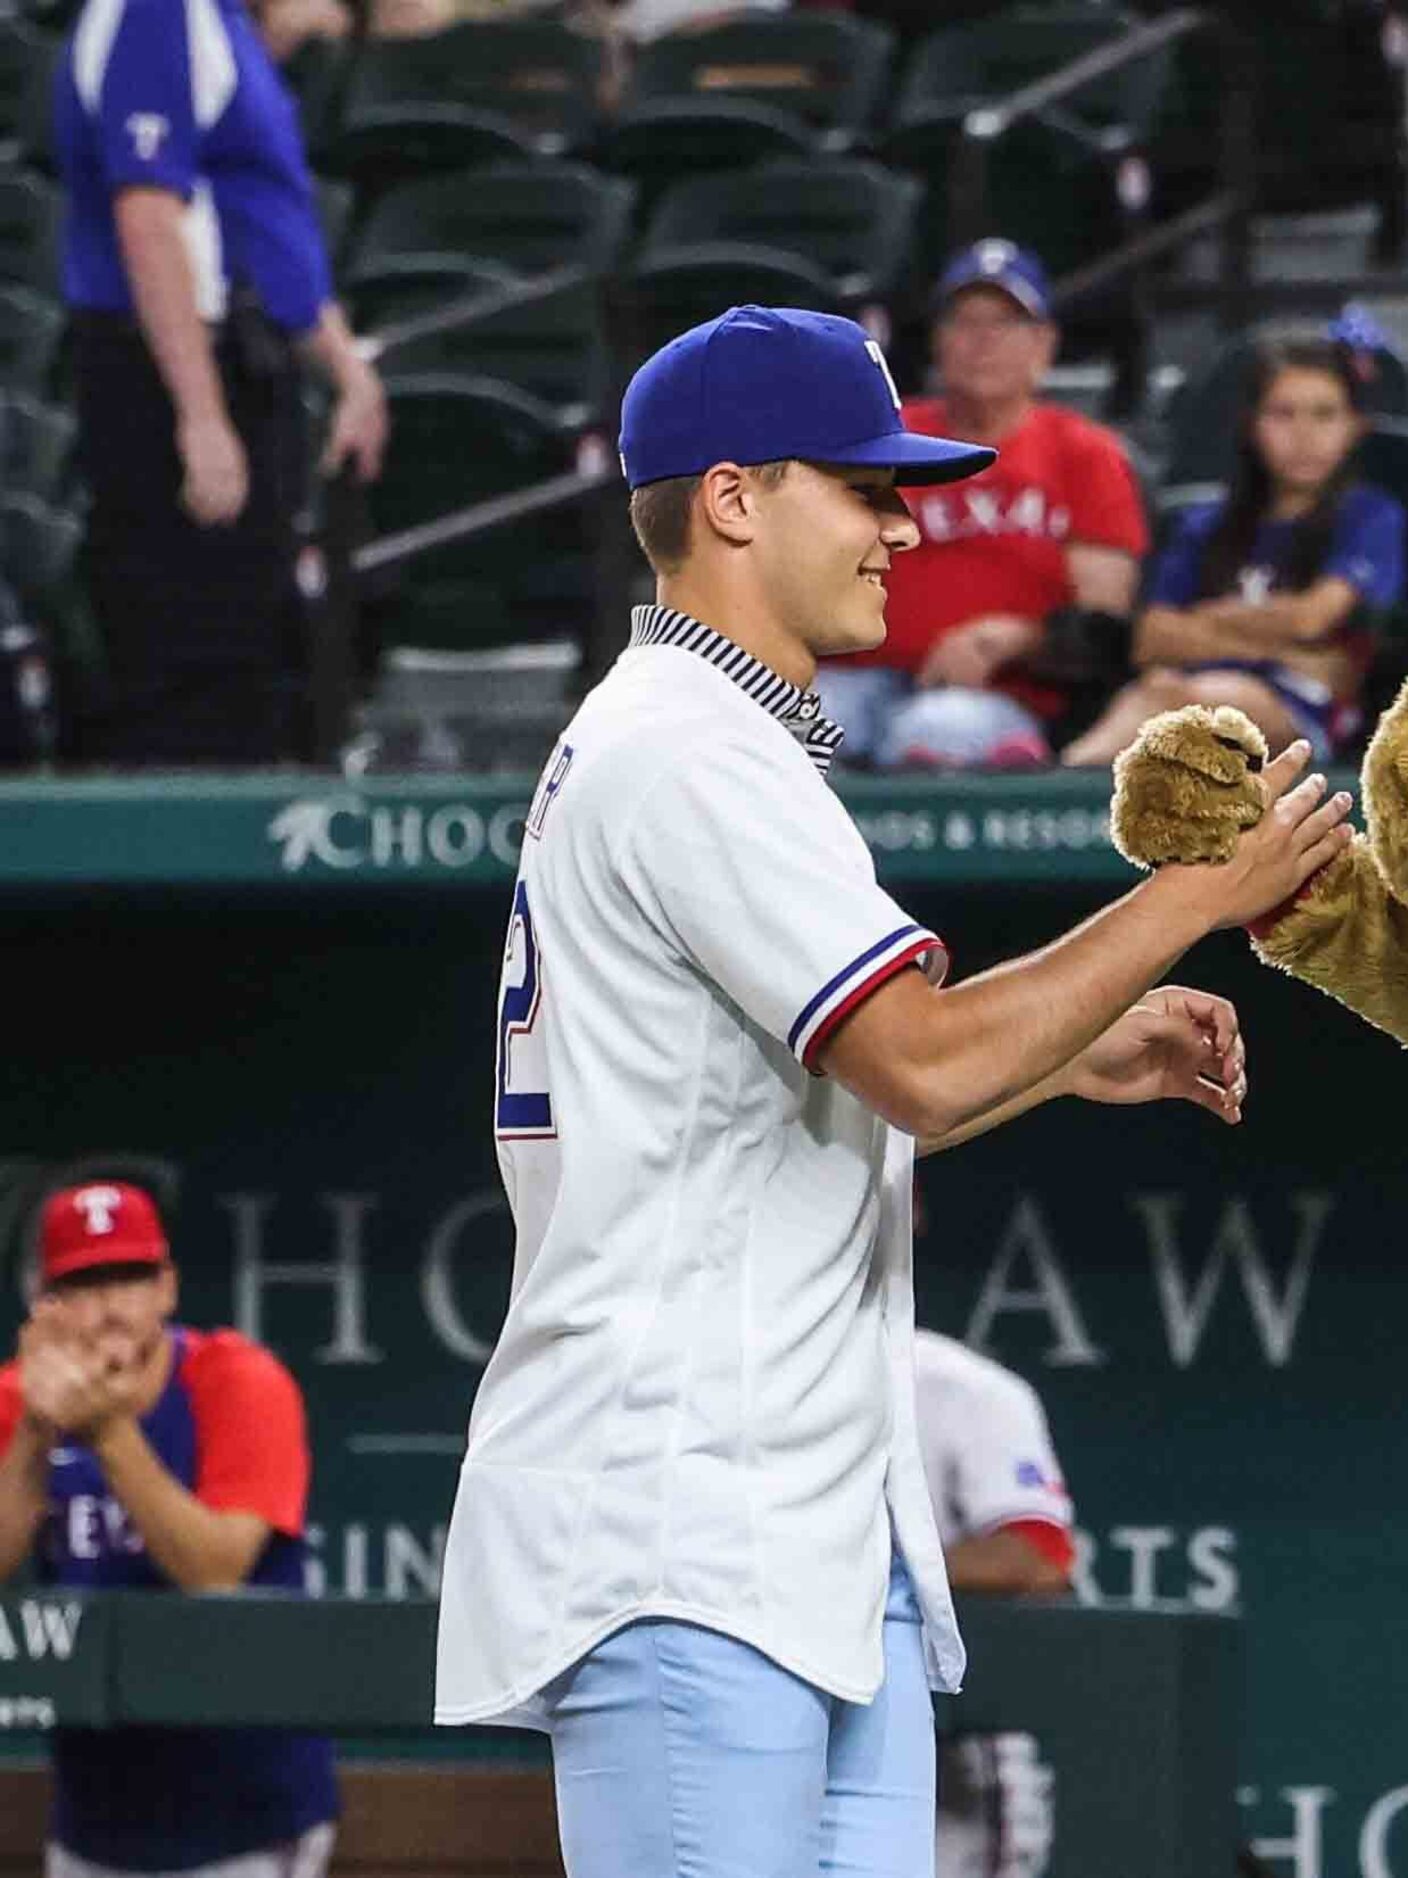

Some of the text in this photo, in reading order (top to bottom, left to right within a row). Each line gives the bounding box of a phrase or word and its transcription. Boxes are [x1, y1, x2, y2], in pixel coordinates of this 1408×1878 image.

[921, 486, 1071, 543] EXAS
[312, 797, 529, 868] CHOC
[72, 1185, 123, 1236] T
